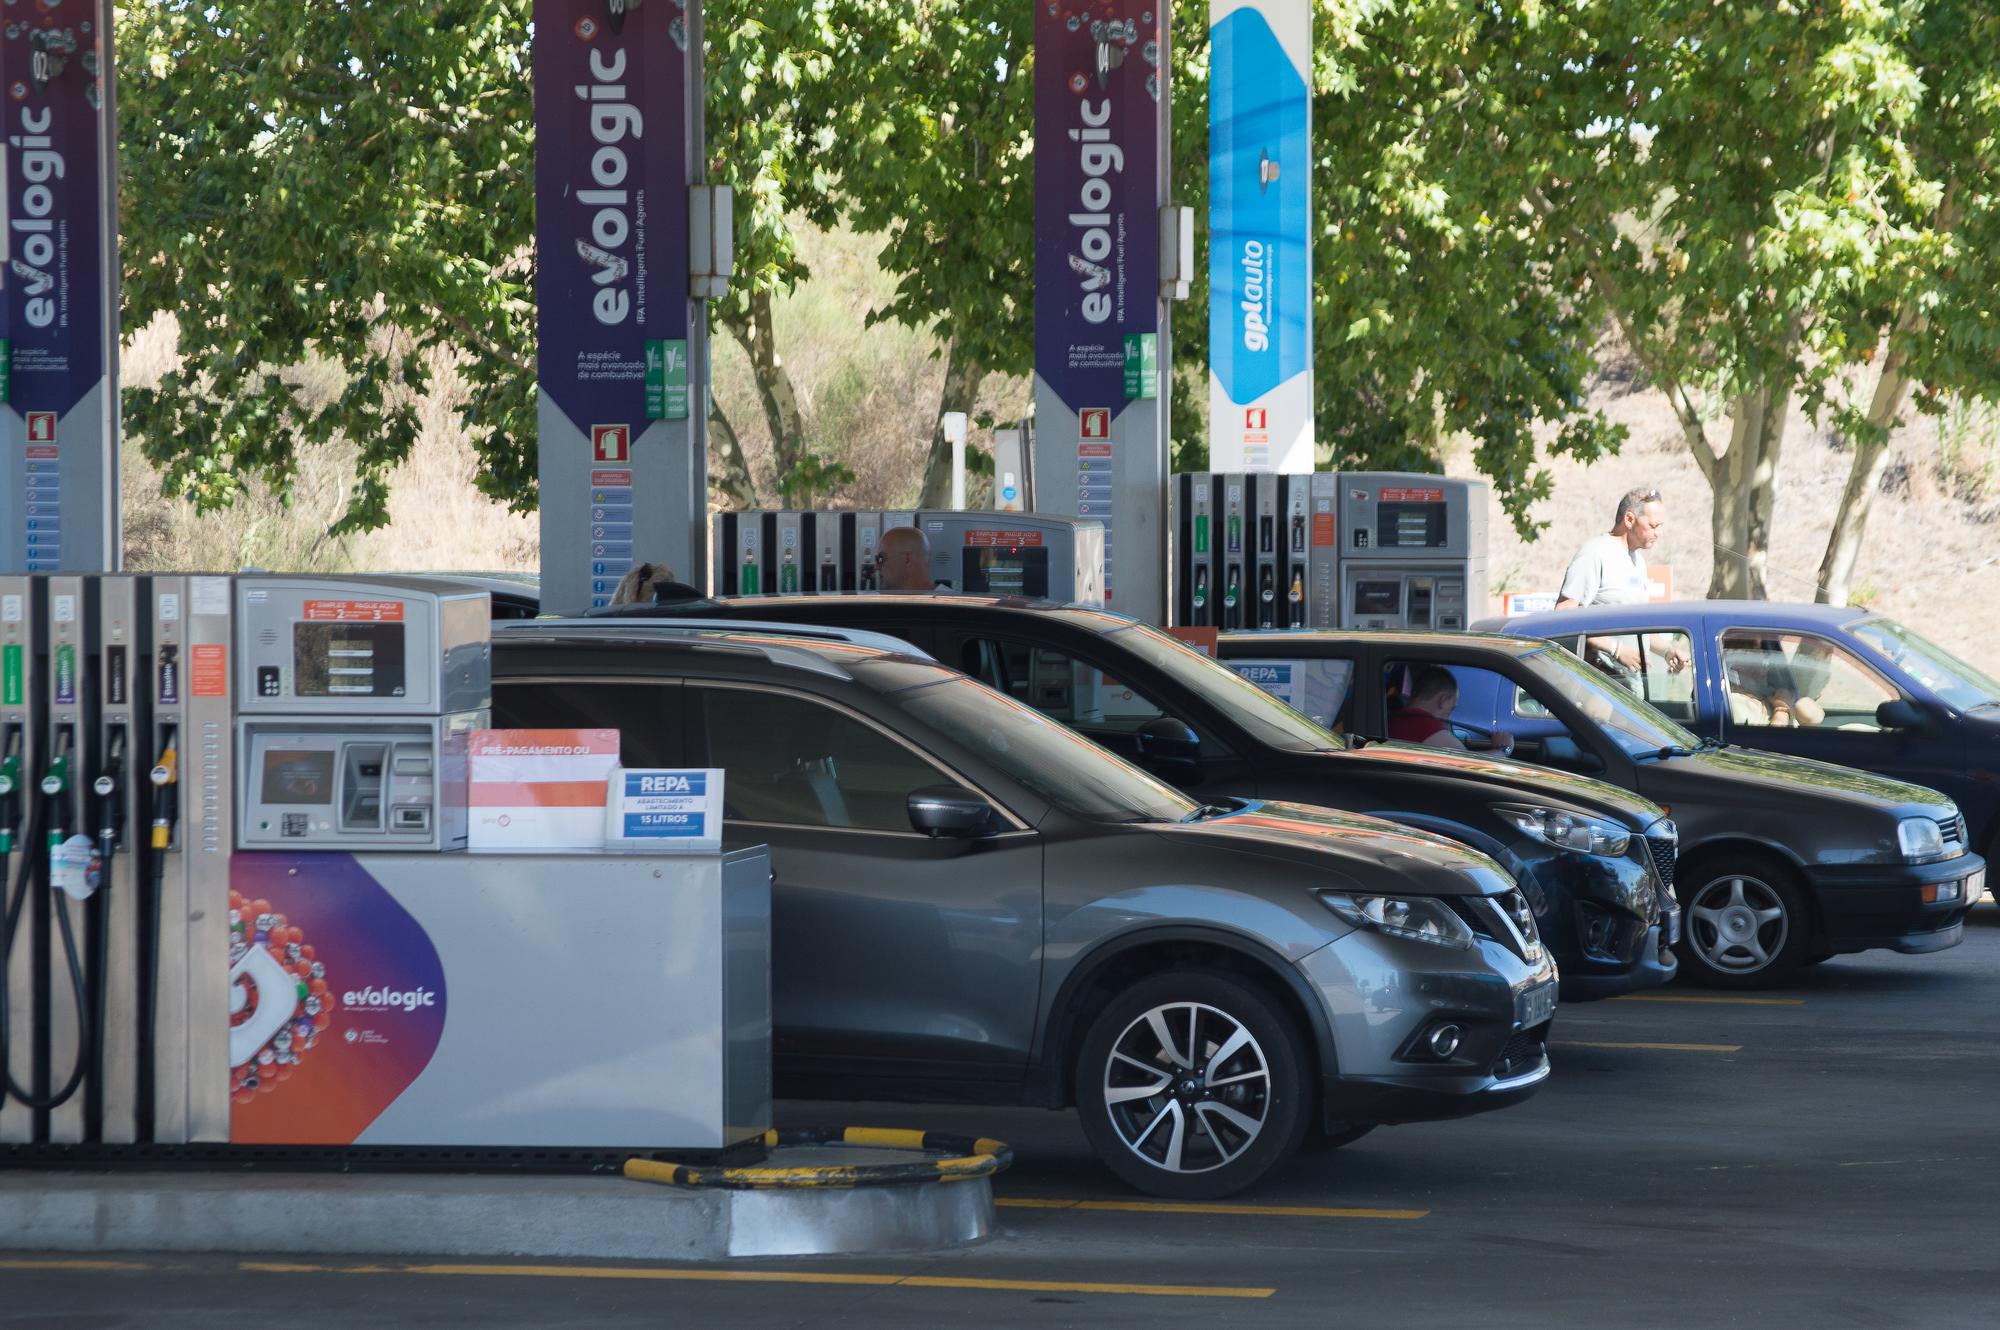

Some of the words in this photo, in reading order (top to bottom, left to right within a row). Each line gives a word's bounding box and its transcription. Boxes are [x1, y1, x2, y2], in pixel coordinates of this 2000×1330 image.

[33, 50, 48, 81] 02
[574, 47, 643, 325] evologic
[10, 106, 65, 328] evologic
[635, 189, 646, 226] Agents
[1067, 97, 1124, 324] evologic
[635, 228, 644, 250] Fuel
[1117, 212, 1127, 243] Agents
[1117, 244, 1125, 263] Fuel
[635, 252, 647, 304] Intelligent
[1116, 264, 1127, 306] Intelligent
[336, 609, 345, 619] 2
[373, 609, 382, 620] 3
[573, 746, 590, 755] OU
[641, 776, 690, 792] REPA
[637, 797, 693, 805] ABASTECIMENTO
[641, 815, 652, 824] 15
[653, 815, 689, 824] LITROS
[343, 986, 435, 1012] evologic
